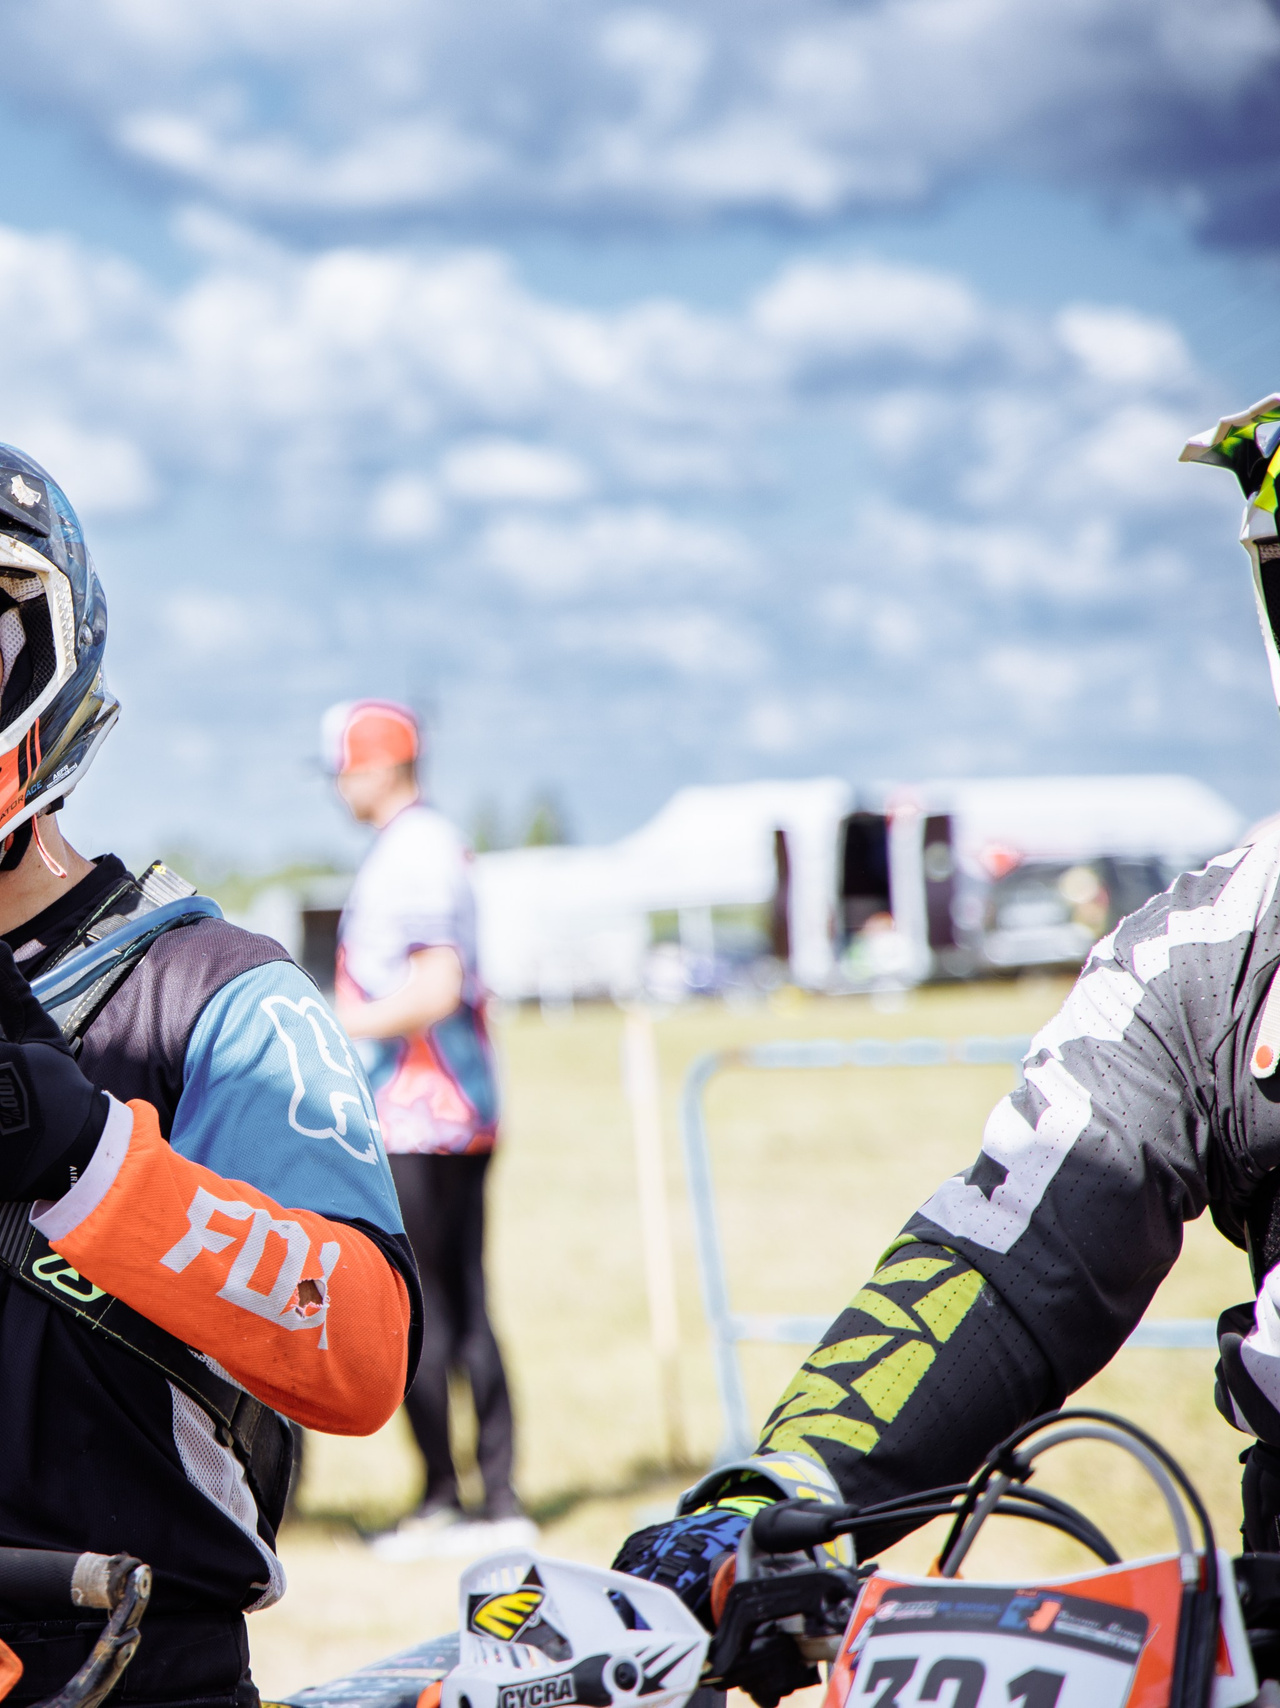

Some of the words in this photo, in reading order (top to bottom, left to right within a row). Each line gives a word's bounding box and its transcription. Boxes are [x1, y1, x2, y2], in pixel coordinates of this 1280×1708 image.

[25, 780, 42, 798] ACE
[158, 1185, 342, 1351] FOX
[500, 1675, 573, 1708] CYCRA
